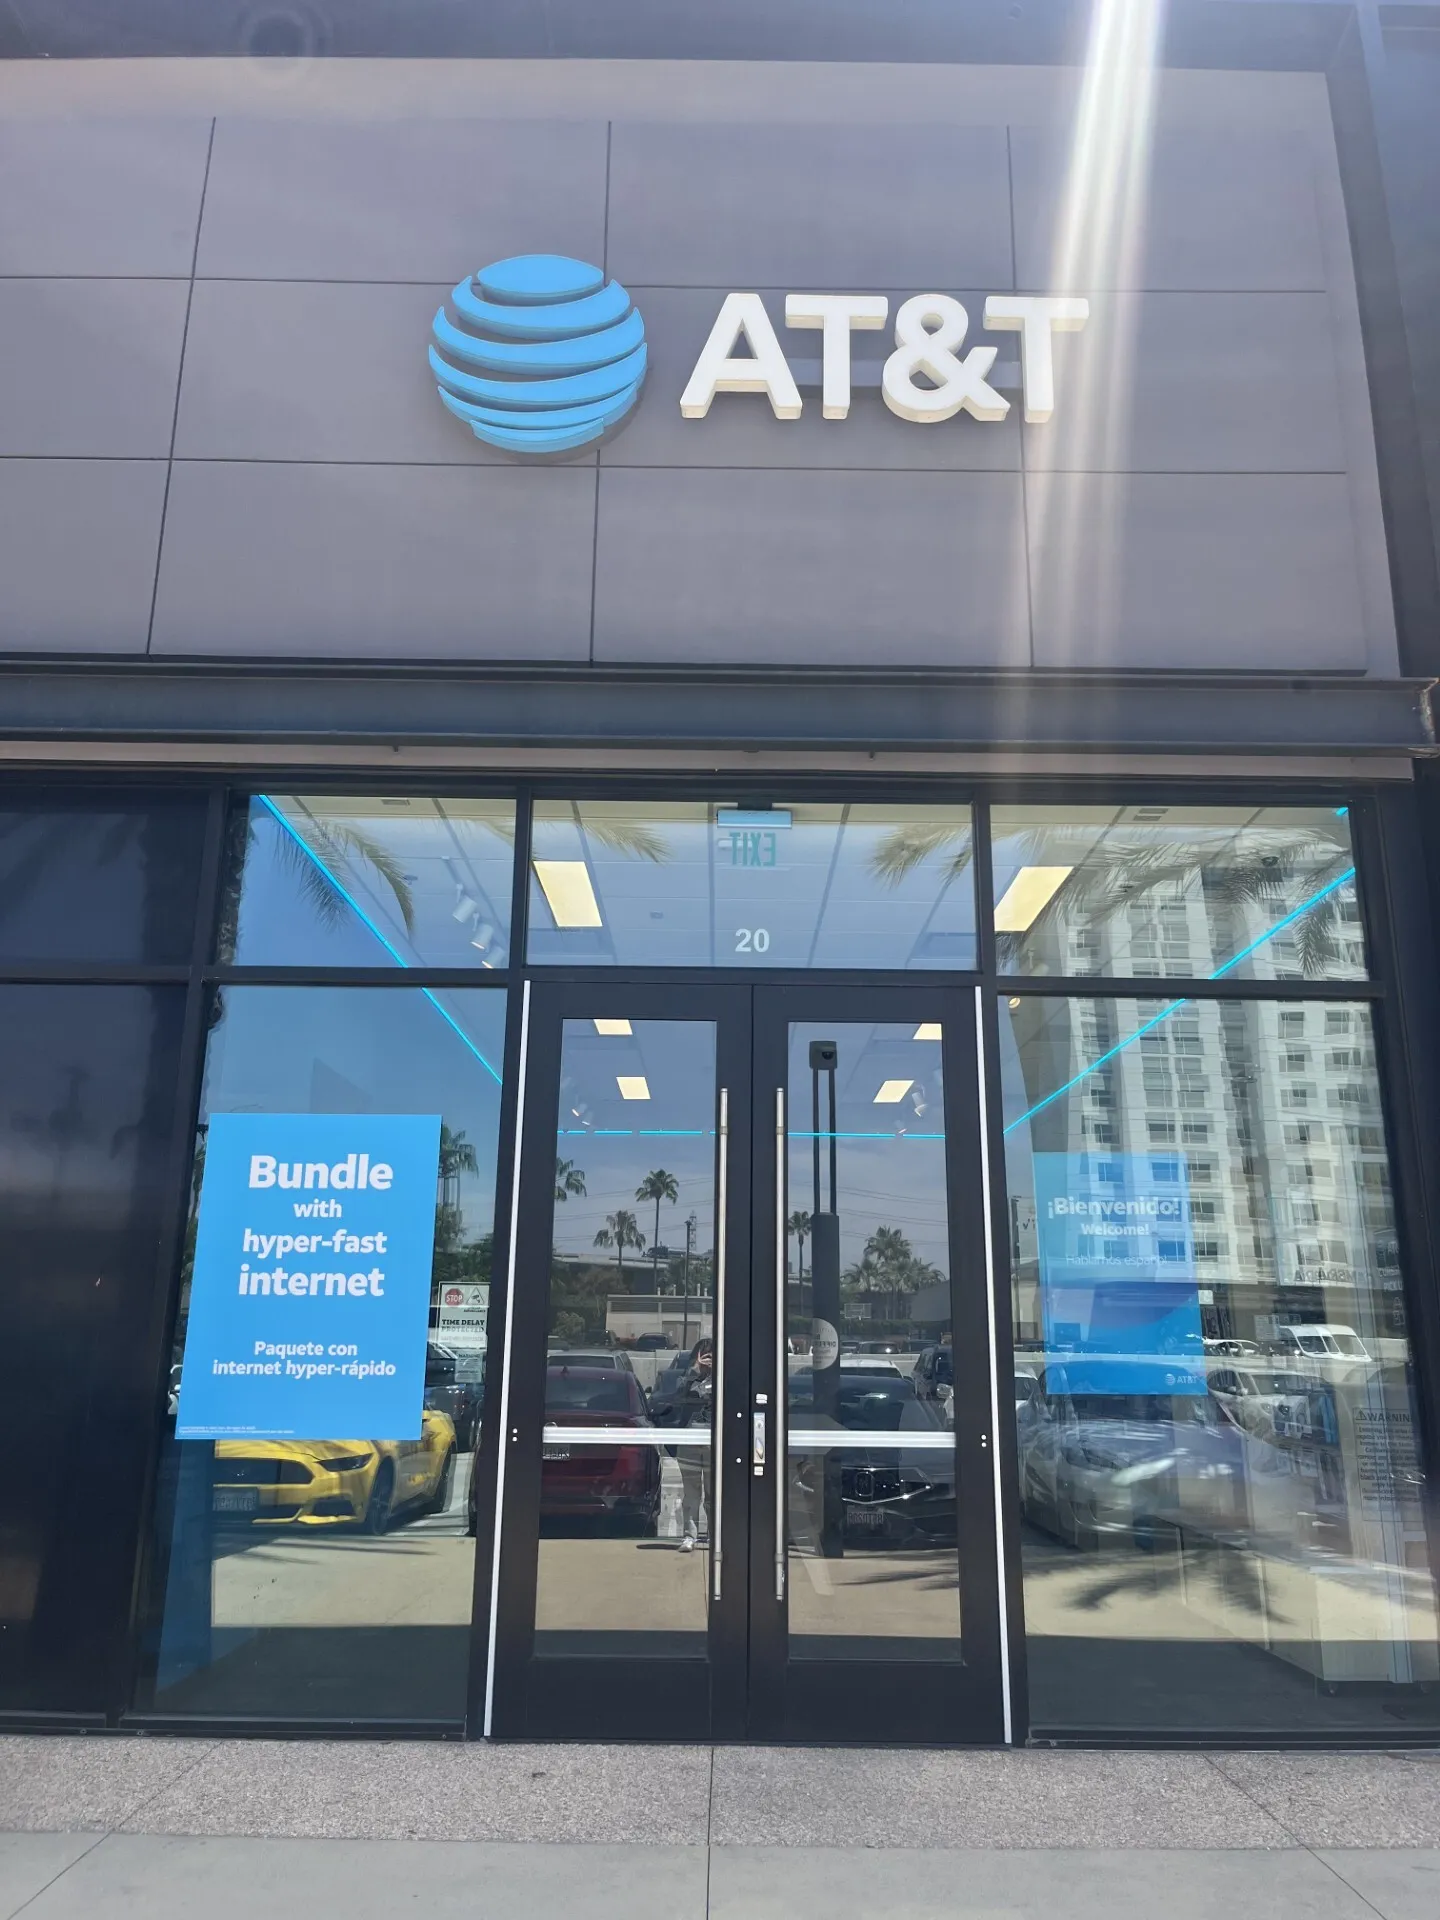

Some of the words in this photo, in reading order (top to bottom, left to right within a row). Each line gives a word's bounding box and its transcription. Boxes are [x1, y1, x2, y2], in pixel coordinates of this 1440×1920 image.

[680, 293, 1089, 423] AT&T
[735, 928, 770, 953] 20
[248, 1154, 394, 1190] Bundle
[293, 1198, 342, 1218] with
[1048, 1196, 1180, 1219] ¡Bienvenido!
[1081, 1223, 1149, 1235] Welcome!
[242, 1228, 387, 1259] hyper-fast
[238, 1264, 385, 1297] internet
[446, 1294, 463, 1303] STOP
[254, 1340, 324, 1359] Paquete
[327, 1344, 358, 1356] con
[212, 1360, 281, 1375] internet
[285, 1359, 396, 1380] hyper-rápido
